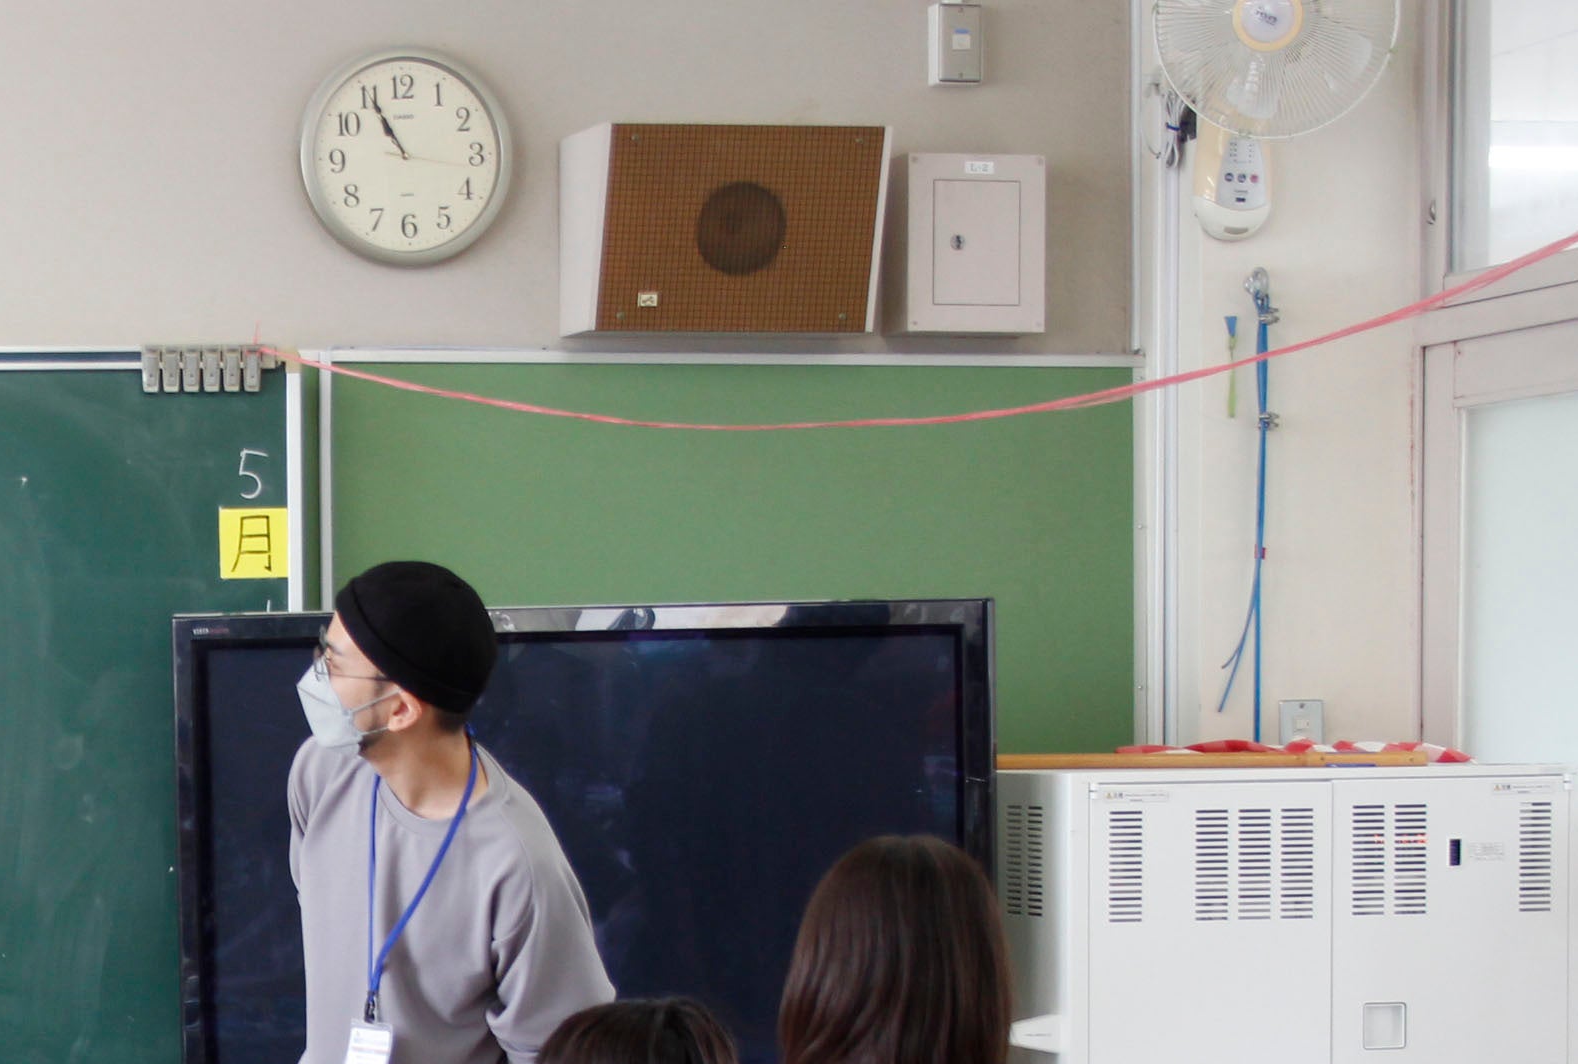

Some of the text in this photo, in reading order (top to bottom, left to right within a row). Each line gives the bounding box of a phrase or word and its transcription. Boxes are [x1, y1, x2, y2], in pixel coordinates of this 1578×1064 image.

[360, 84, 378, 110] 11
[390, 74, 414, 100] 12
[433, 82, 444, 107] 1
[337, 111, 360, 137] 10
[456, 106, 471, 132] 2
[329, 148, 346, 173] 9
[468, 142, 485, 166] 3
[343, 183, 360, 208] 8
[457, 177, 474, 200] 4
[370, 207, 385, 232] 7
[400, 214, 418, 239] 6
[436, 206, 451, 230] 5
[238, 448, 269, 500] 5
[231, 514, 272, 572] 月
